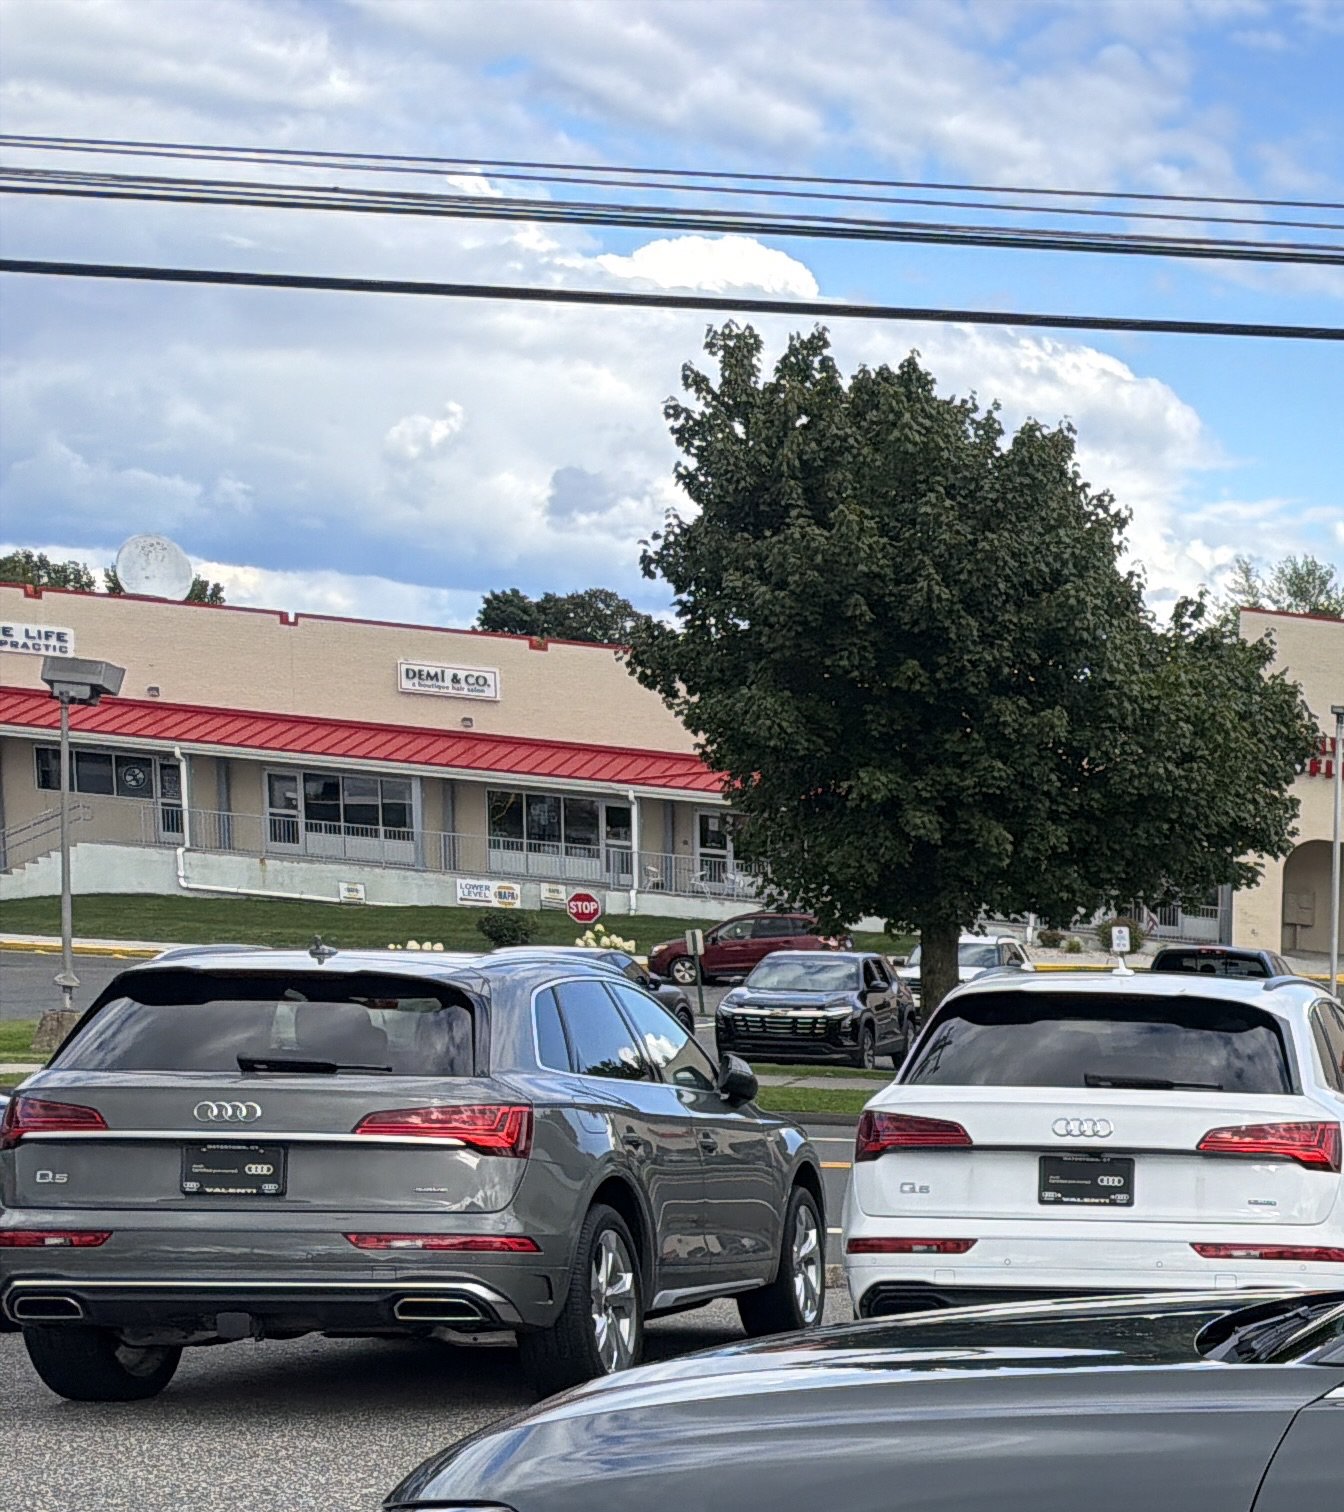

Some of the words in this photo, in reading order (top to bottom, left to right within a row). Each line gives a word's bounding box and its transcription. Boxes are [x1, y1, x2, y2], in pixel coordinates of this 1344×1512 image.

[25, 628, 68, 643] LIFE
[0, 639, 68, 654] PRACTIC
[451, 673, 461, 684] &
[465, 674, 491, 688] CO.
[459, 882, 491, 892] LOWER
[462, 890, 489, 898] LEVEL
[569, 901, 598, 914] STOP
[36, 1170, 68, 1183] Q5
